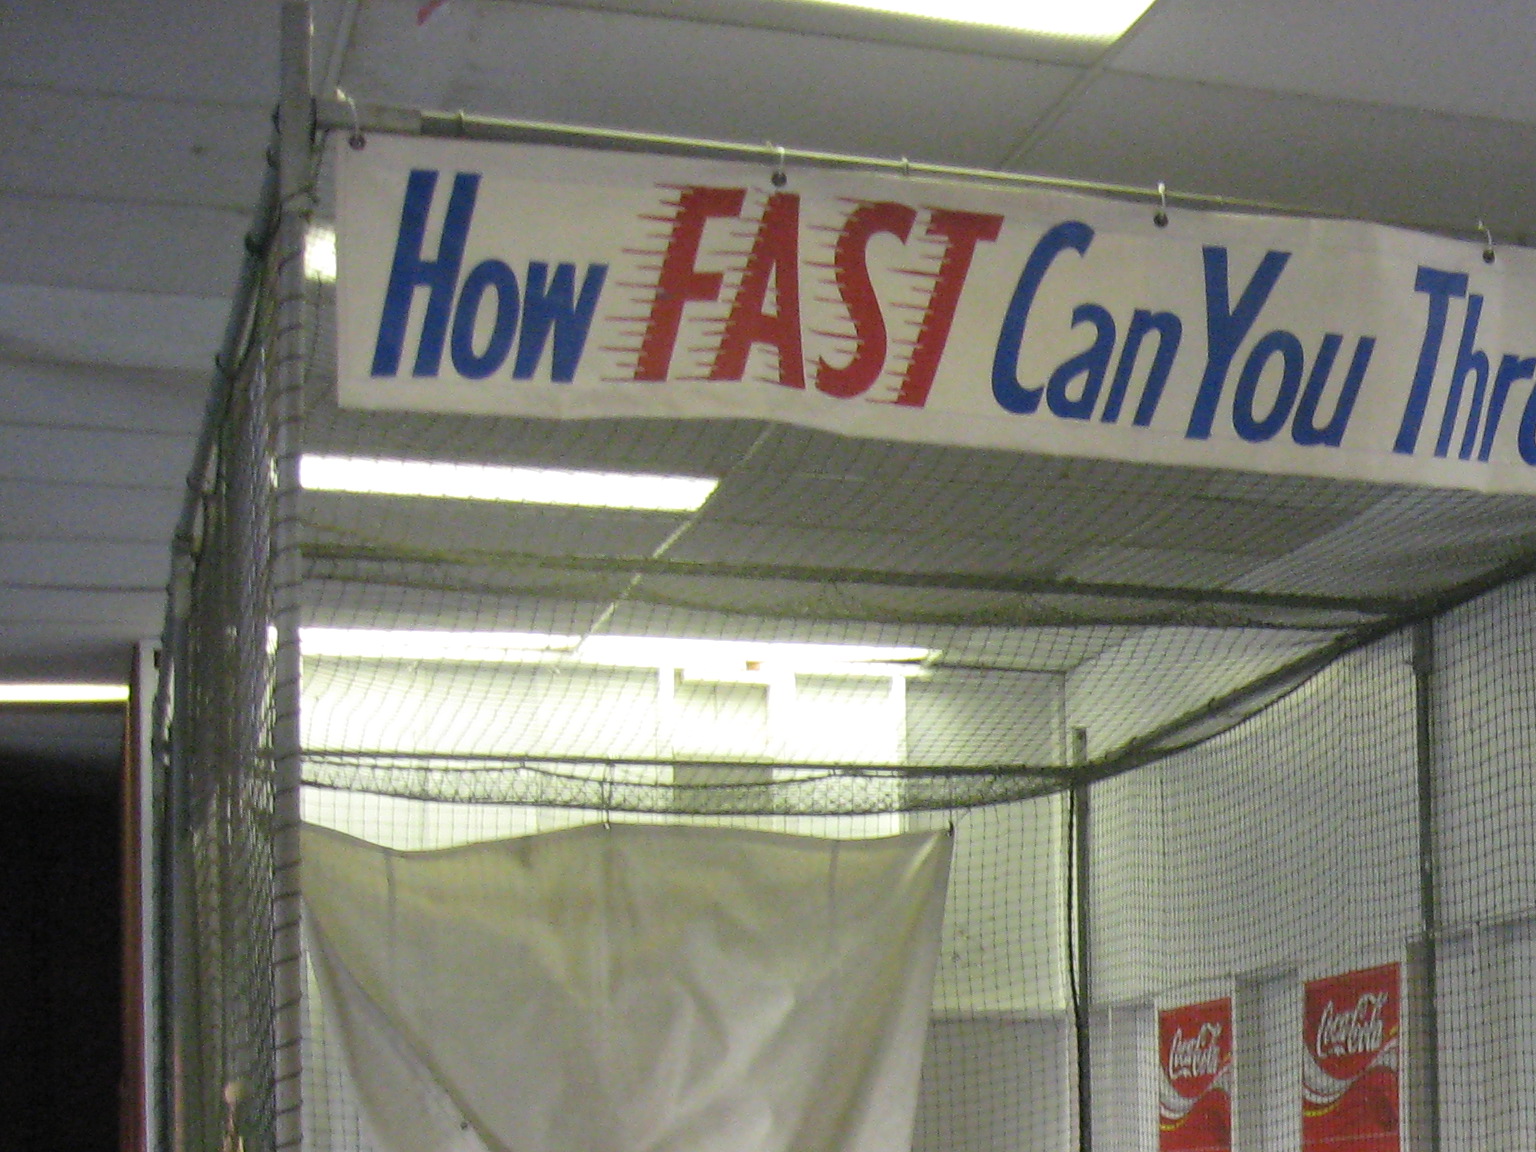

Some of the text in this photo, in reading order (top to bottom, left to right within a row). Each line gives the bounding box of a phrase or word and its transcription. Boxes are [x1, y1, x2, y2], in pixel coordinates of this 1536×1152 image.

[370, 169, 607, 383] How
[630, 184, 1004, 408] FAST
[992, 219, 1183, 428] Can
[1186, 245, 1376, 447] You
[1316, 992, 1388, 1057] Coca-Cola
